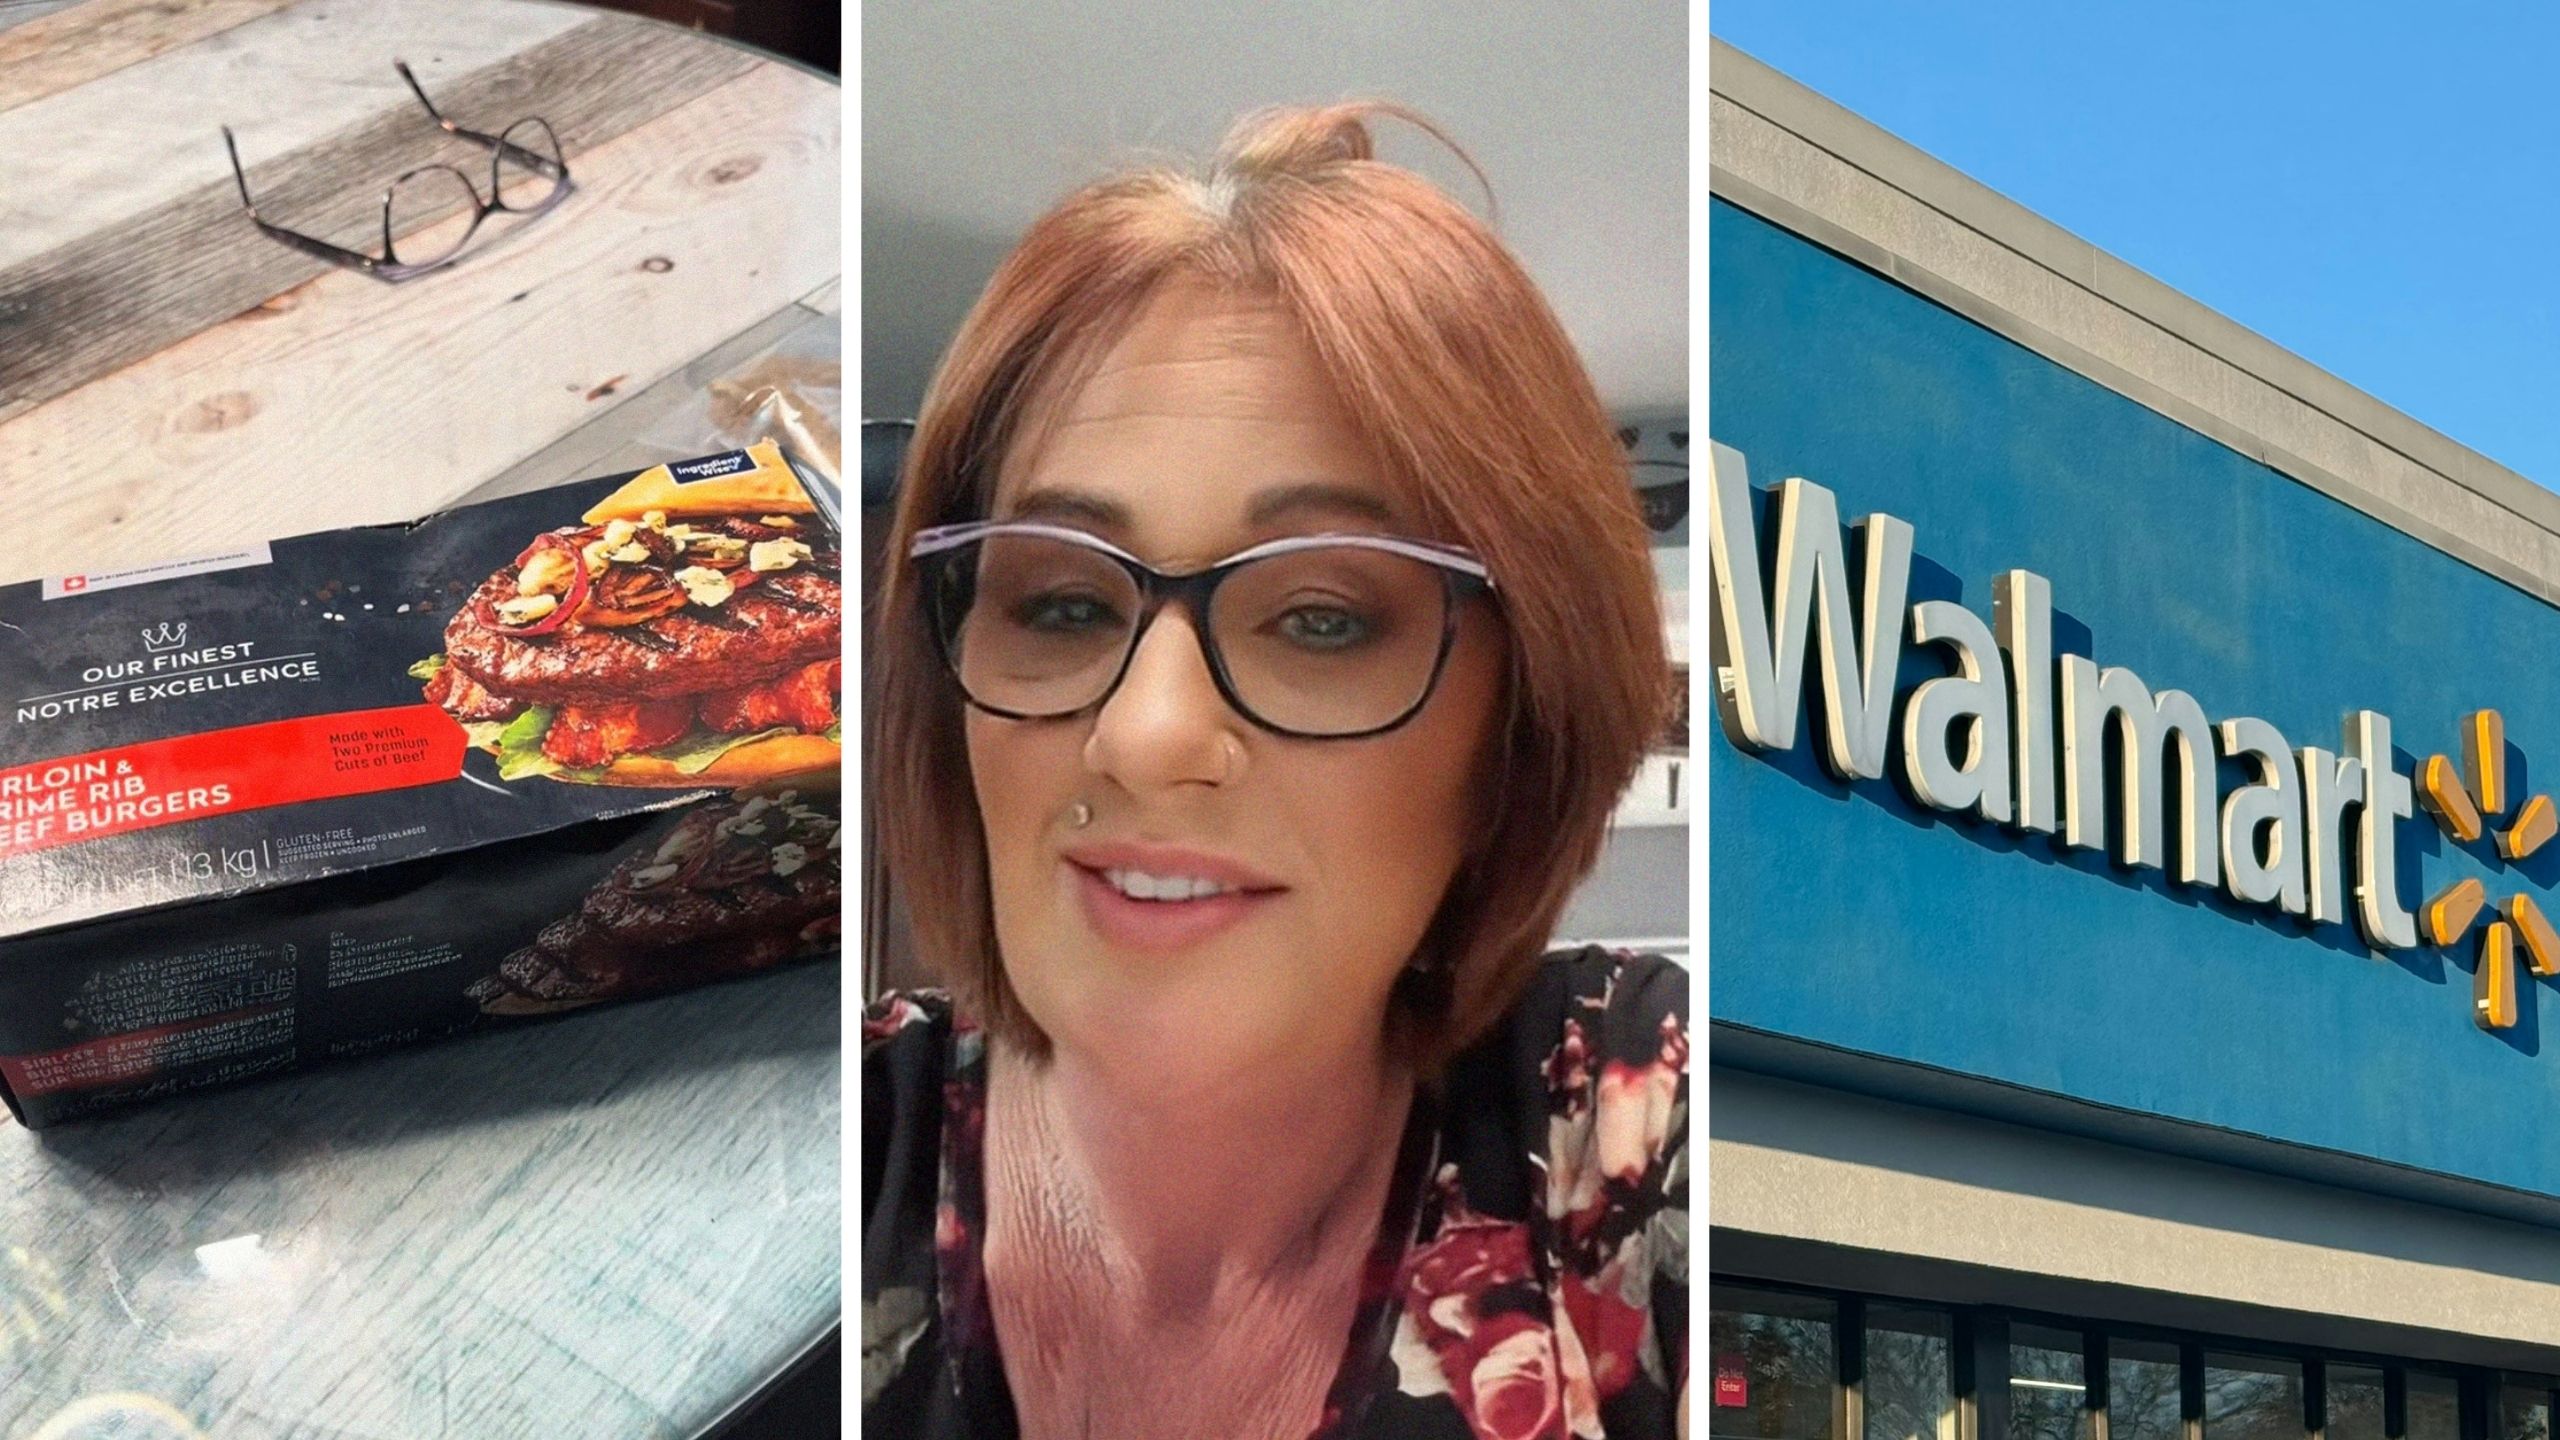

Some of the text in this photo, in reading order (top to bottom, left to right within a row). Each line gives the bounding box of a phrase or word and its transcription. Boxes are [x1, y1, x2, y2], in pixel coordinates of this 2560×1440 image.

[83, 642, 254, 682] OUR FINEST
[17, 661, 320, 723] NOTRE EXCELLENCE
[1709, 440, 2417, 950] Walmart
[329, 726, 404, 744] Made with
[333, 737, 429, 757] Two Premium
[335, 749, 426, 772] Cuts of Beef
[2, 758, 132, 797] RLOIN &
[89, 776, 146, 803] RIB
[66, 784, 232, 833] BURGERS
[276, 828, 354, 849] GLUTEN-FREE
[323, 839, 356, 850] SERVING
[221, 847, 257, 879] kg
[1720, 1380, 1741, 1392] Enter
